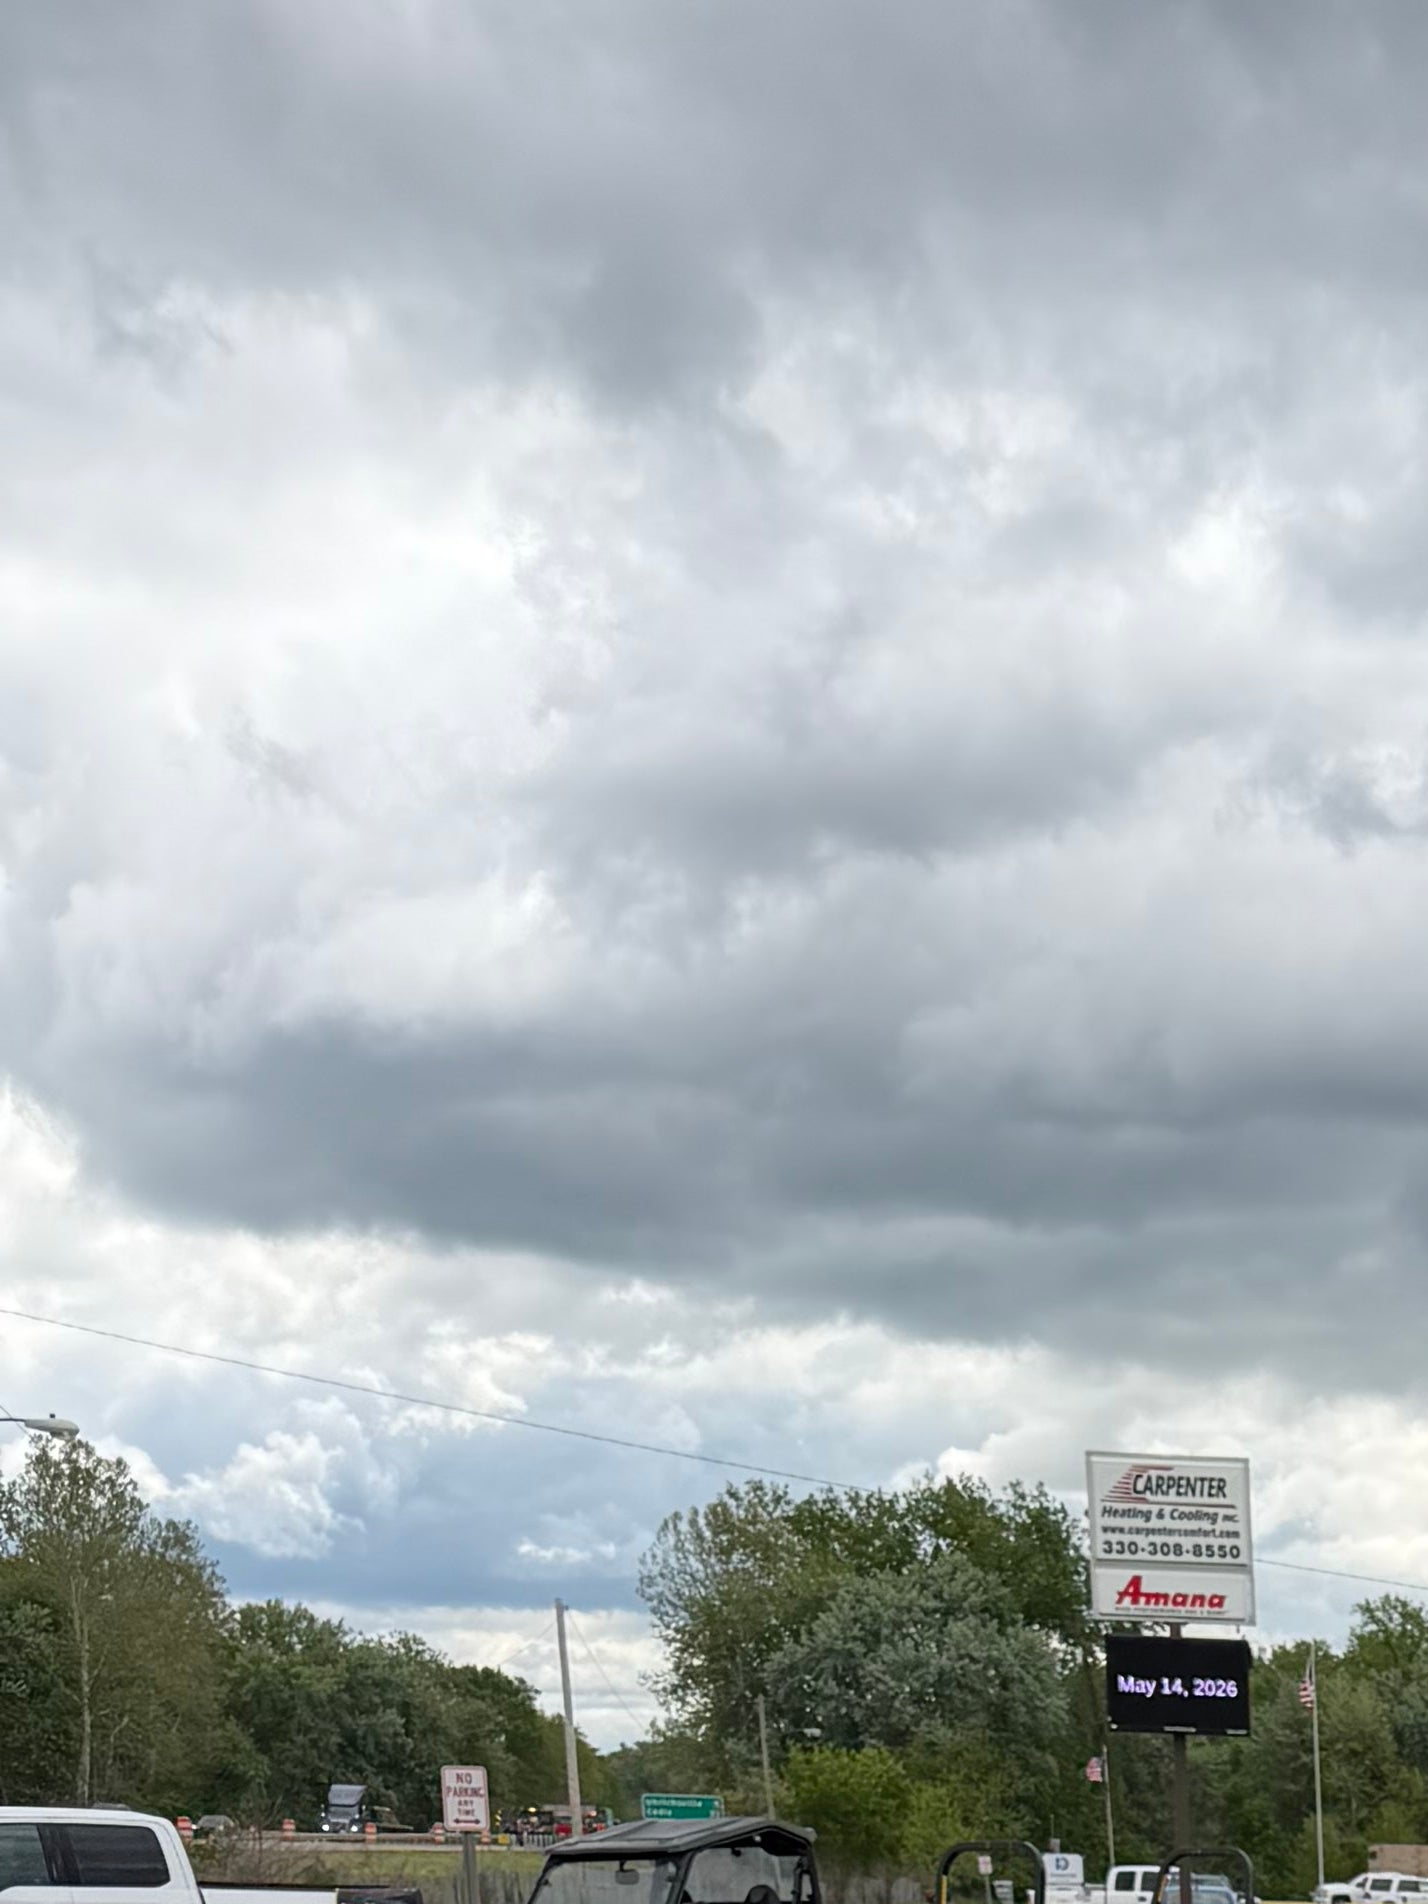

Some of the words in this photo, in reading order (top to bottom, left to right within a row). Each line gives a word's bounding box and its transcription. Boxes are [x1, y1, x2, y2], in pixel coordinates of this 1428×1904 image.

[1132, 1474, 1227, 1498] CARPENTER
[1101, 1506, 1153, 1523] Heating
[1156, 1508, 1165, 1520] &
[1169, 1508, 1219, 1525] Cooling
[1115, 1575, 1227, 1609] Amana
[1117, 1675, 1156, 1698] May
[1160, 1677, 1189, 1698] 14,
[1192, 1677, 1238, 1698] 2026
[456, 1772, 473, 1785] NO
[446, 1785, 485, 1798] PARKING
